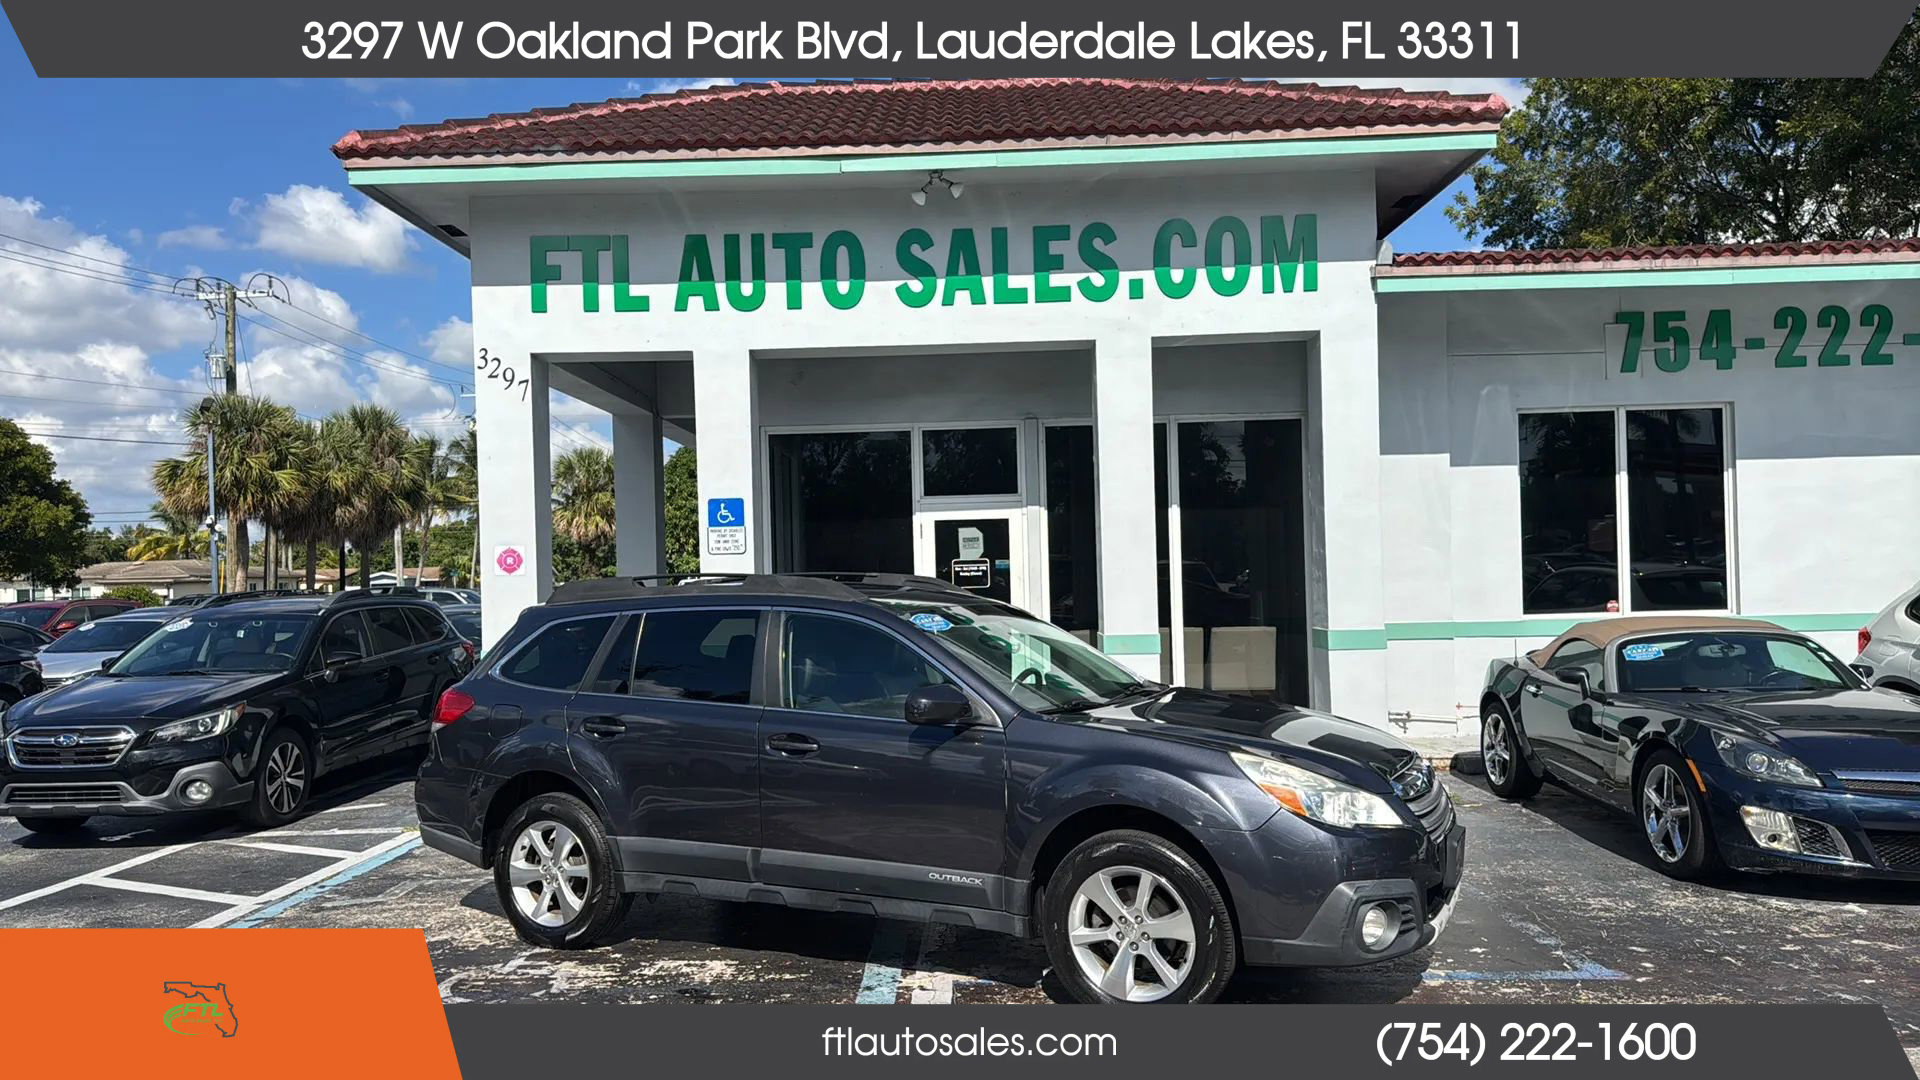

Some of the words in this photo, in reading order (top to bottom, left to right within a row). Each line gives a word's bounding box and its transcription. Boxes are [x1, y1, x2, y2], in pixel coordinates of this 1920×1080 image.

[530, 234, 650, 313] FTL
[674, 230, 866, 312] AUTO
[896, 213, 1319, 308] SALES.COM
[477, 347, 530, 402] 3297
[928, 872, 983, 886] OUTBACK
